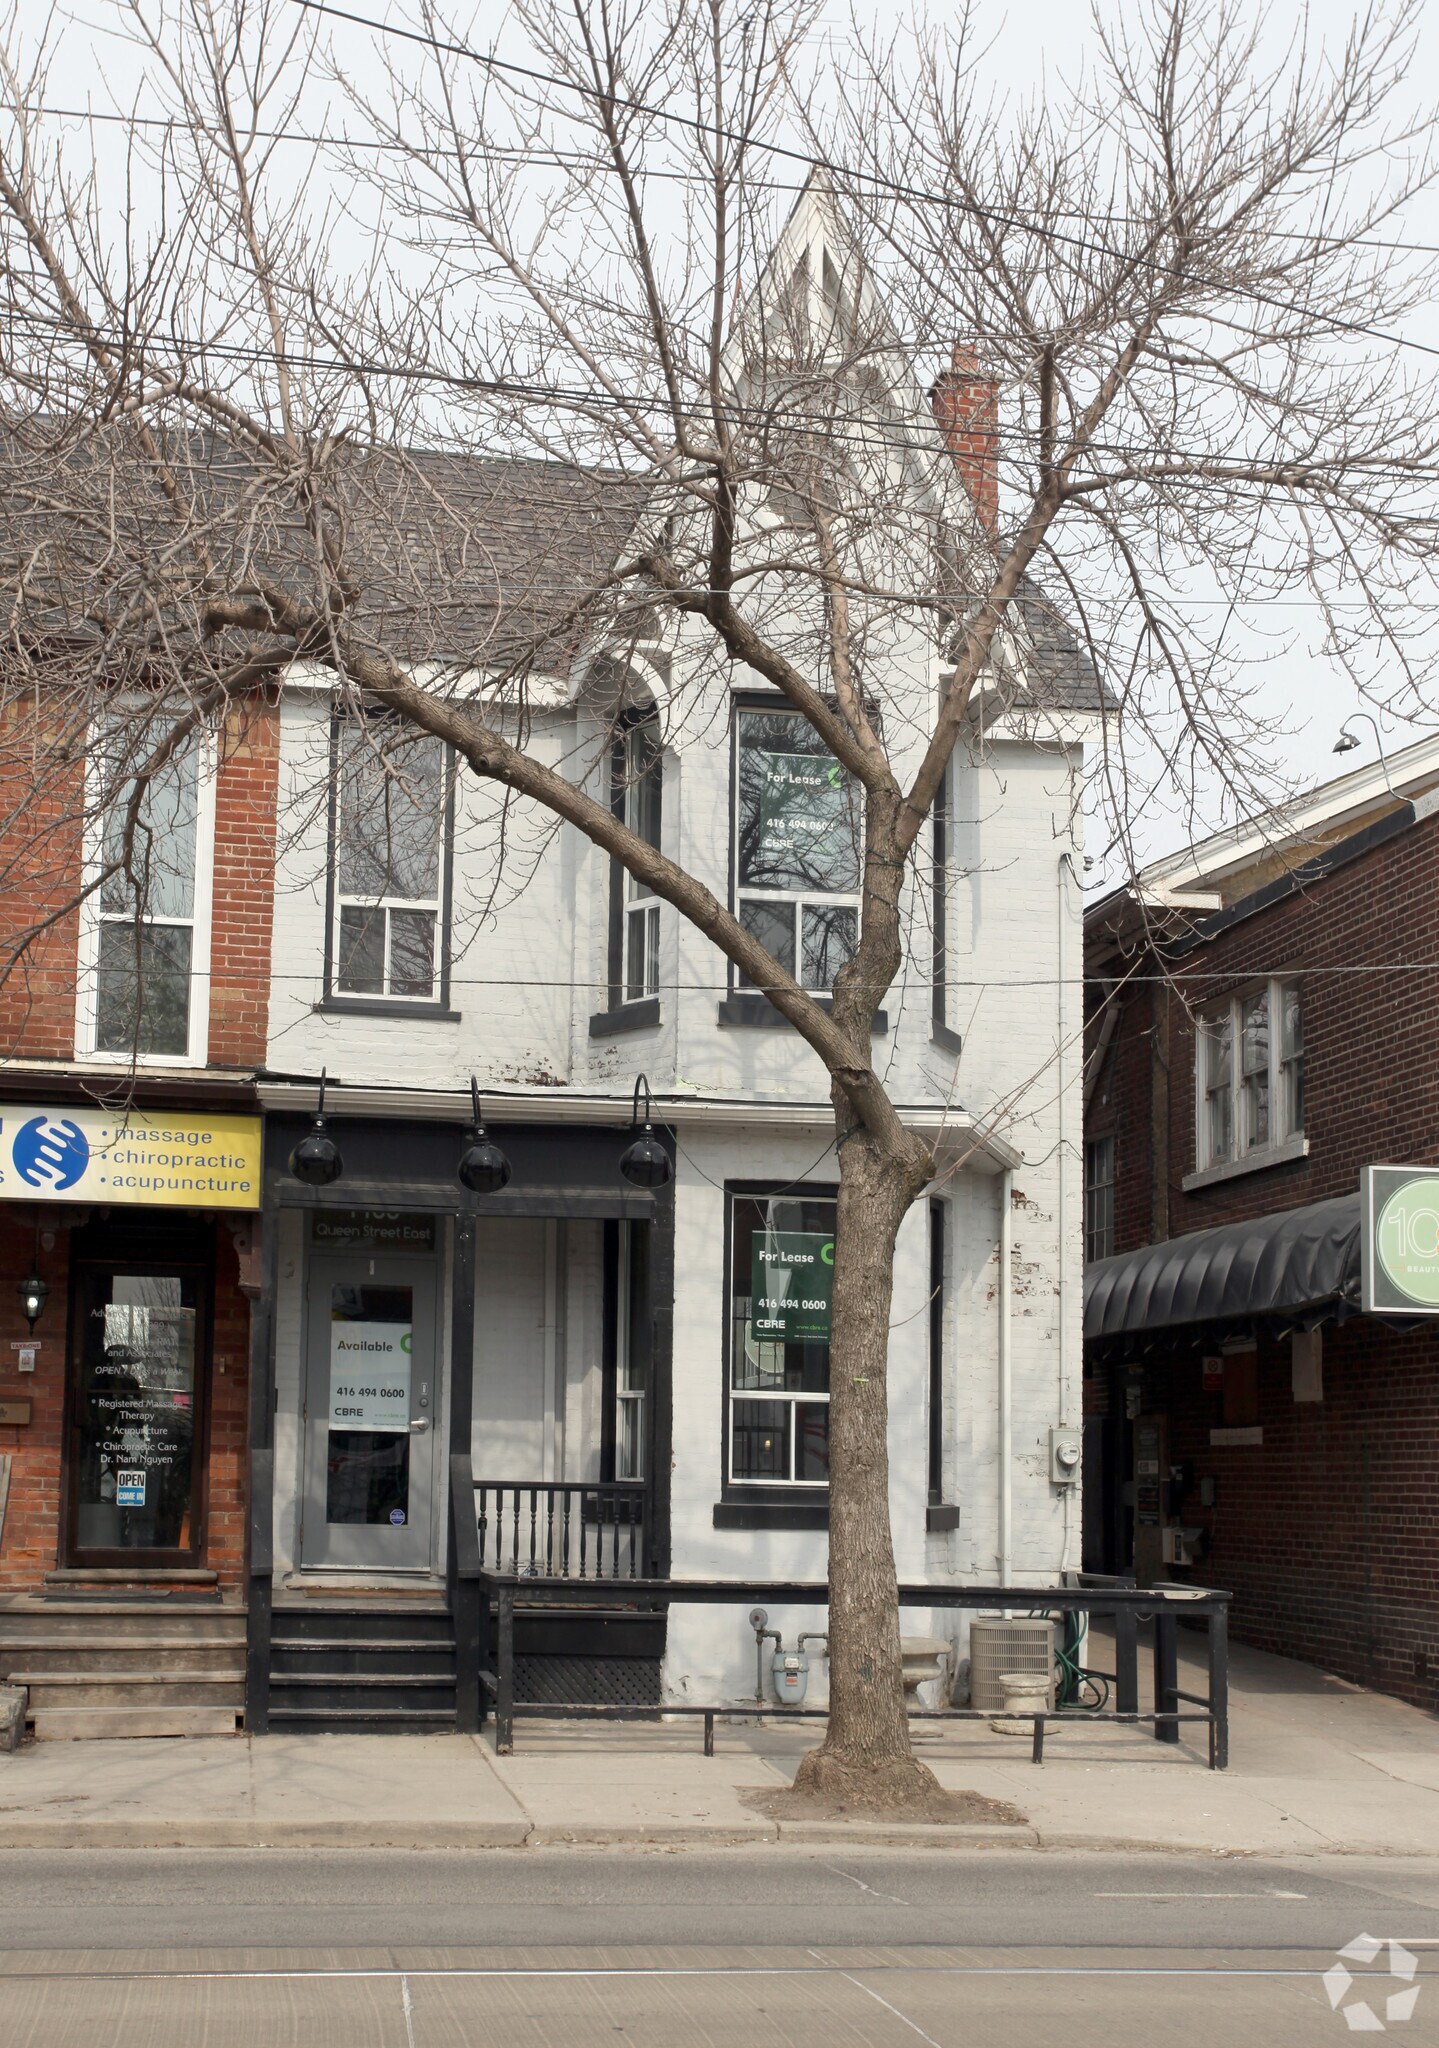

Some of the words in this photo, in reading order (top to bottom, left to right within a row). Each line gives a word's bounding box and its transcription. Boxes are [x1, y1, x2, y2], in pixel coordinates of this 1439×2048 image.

[767, 772, 786, 782] For
[789, 773, 822, 785] Lease
[766, 818, 785, 828] 416
[788, 820, 807, 829] 494
[115, 1127, 213, 1145] massage
[113, 1150, 246, 1169] chiropractic
[112, 1175, 250, 1192] acupuncture
[316, 1223, 360, 1236] Queen
[363, 1225, 400, 1238] Street
[403, 1226, 432, 1240] East
[759, 1251, 778, 1261] For
[781, 1251, 814, 1263] Lease
[758, 1299, 777, 1308] 416
[780, 1299, 799, 1309] 494
[802, 1300, 827, 1309] 0600
[756, 1319, 786, 1329] CBRE
[337, 1340, 393, 1352] Available
[108, 1349, 125, 1358] and
[95, 1366, 121, 1375] OPEN
[336, 1387, 355, 1396] 416
[358, 1388, 377, 1397] 494
[380, 1388, 405, 1398] 0600
[98, 1399, 144, 1410] Registered
[146, 1400, 183, 1410] Massage
[120, 1411, 155, 1421] Therapy
[334, 1408, 364, 1417] CBRE
[113, 1426, 168, 1437] Acupuncture
[103, 1441, 155, 1452] Chiropractic
[157, 1442, 178, 1451] Care
[100, 1454, 114, 1463] Dr.
[116, 1454, 137, 1463] Nam
[139, 1455, 173, 1466] Nguyen
[118, 1474, 145, 1487] OPEN
